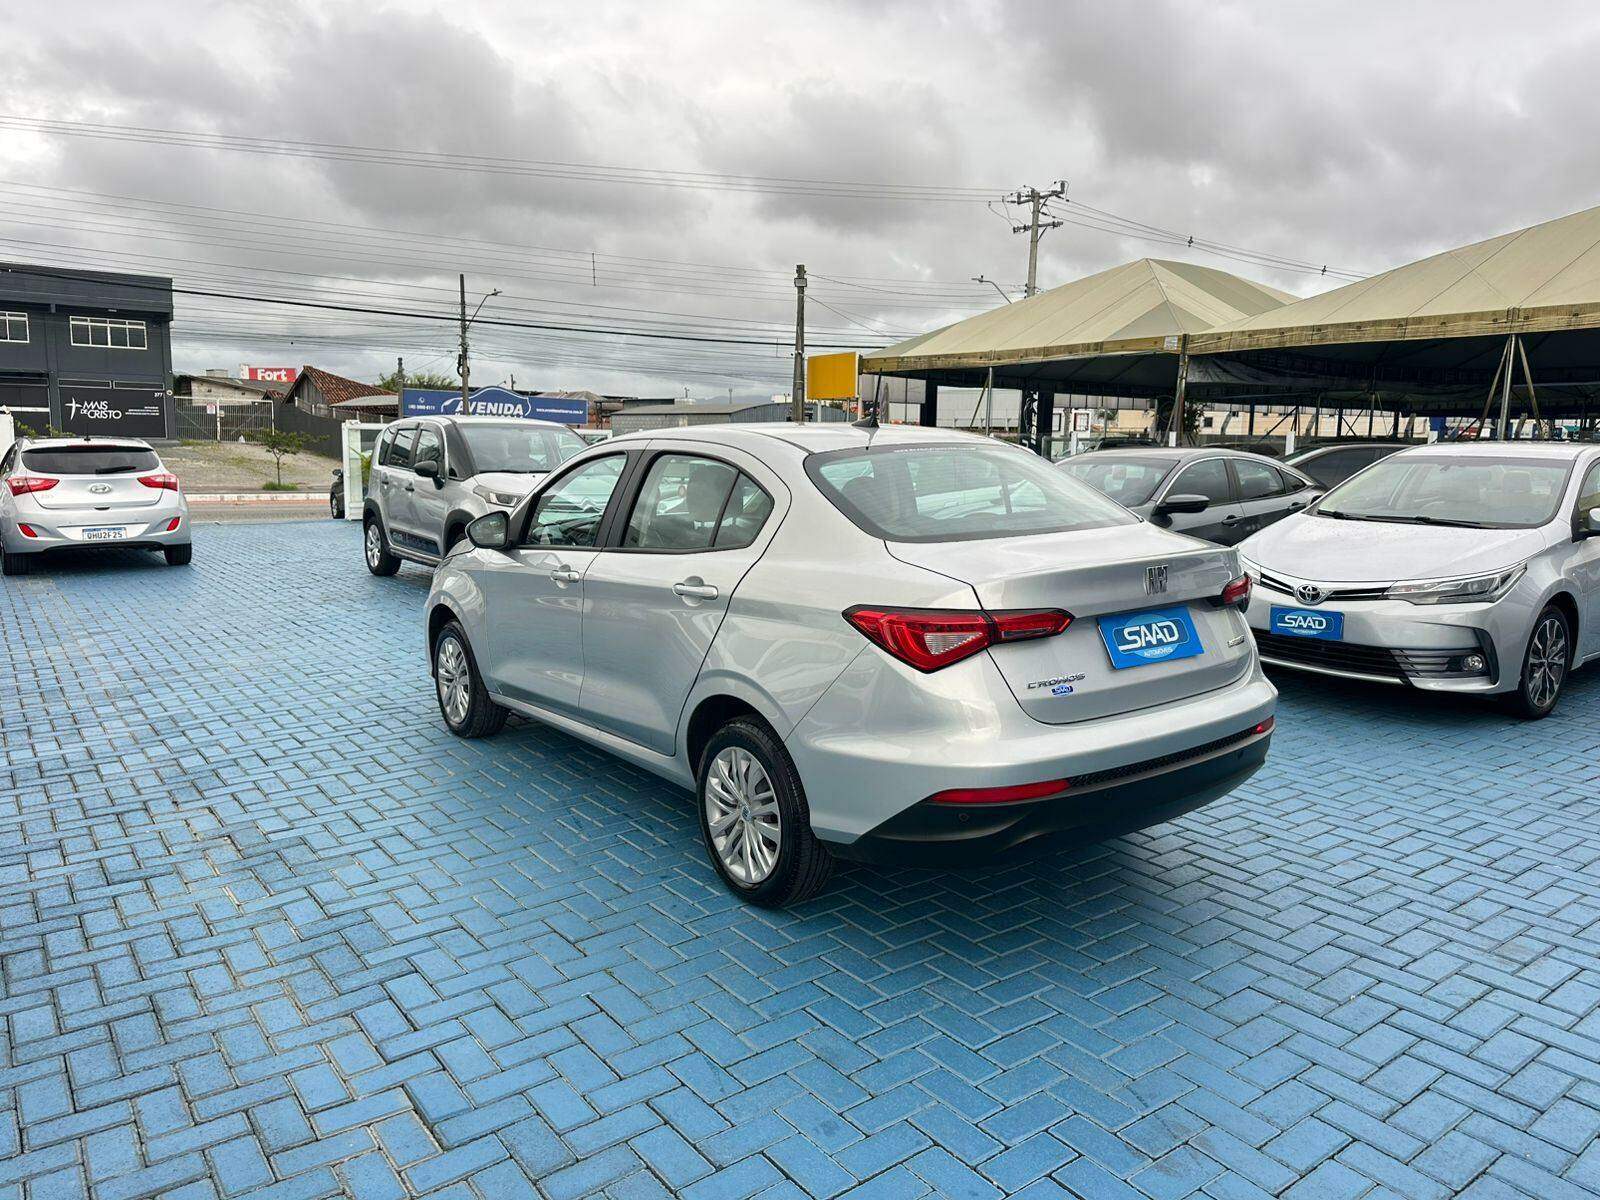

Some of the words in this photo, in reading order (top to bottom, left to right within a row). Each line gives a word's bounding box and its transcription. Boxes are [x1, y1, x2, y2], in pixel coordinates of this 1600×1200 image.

[257, 368, 287, 382] Fort
[82, 400, 108, 410] MAIS
[455, 400, 524, 415] AVENIDA
[87, 410, 122, 419] CRISTO
[1274, 615, 1327, 630] SAAD
[1118, 620, 1180, 651] SAAD
[1026, 671, 1087, 690] CRONOS
